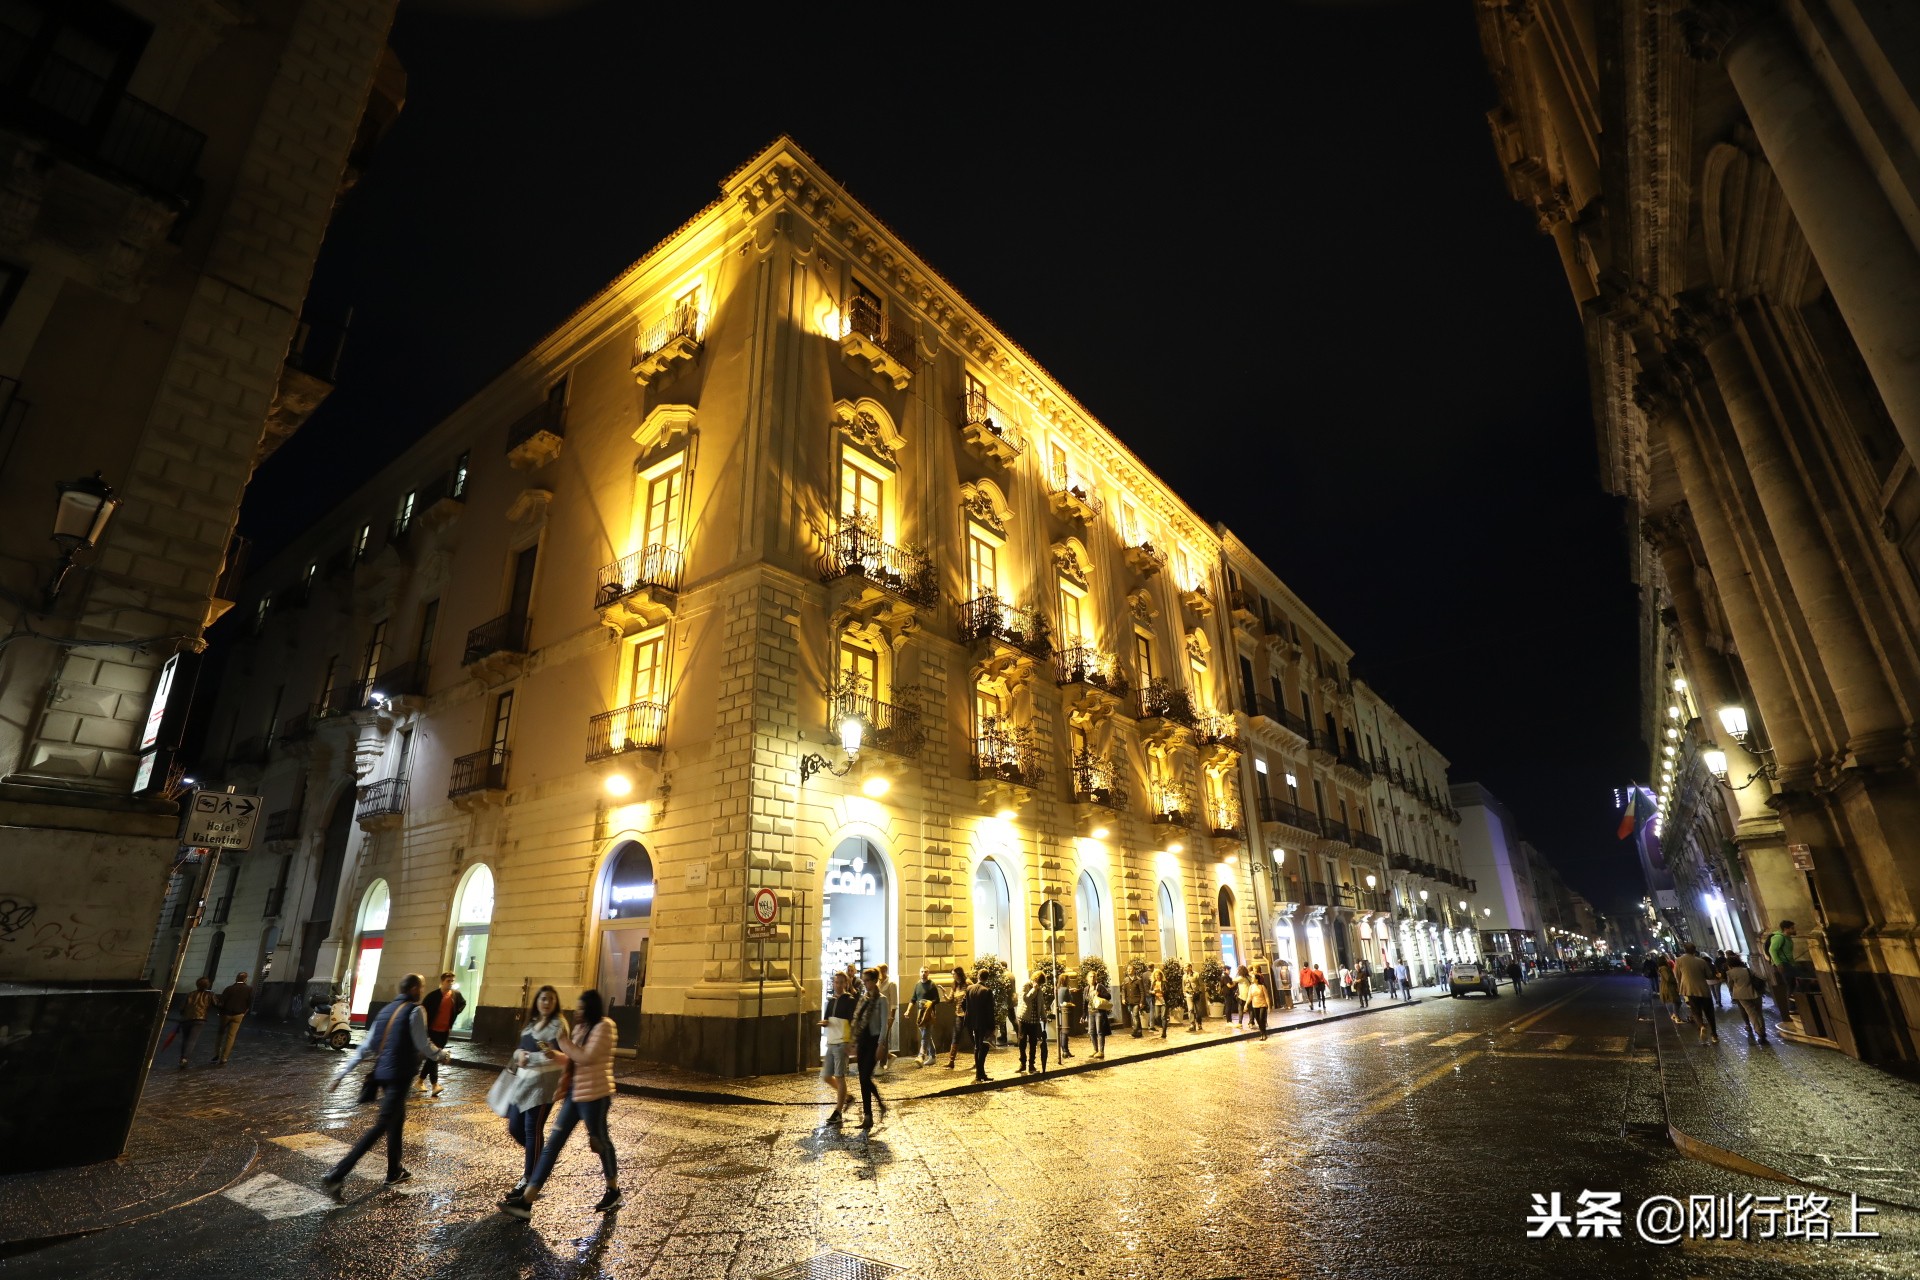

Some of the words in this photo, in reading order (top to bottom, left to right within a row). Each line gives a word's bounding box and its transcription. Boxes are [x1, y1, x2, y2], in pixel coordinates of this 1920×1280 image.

[207, 821, 234, 833] Hotel
[192, 832, 242, 845] Valentino
[825, 857, 876, 895] coin
